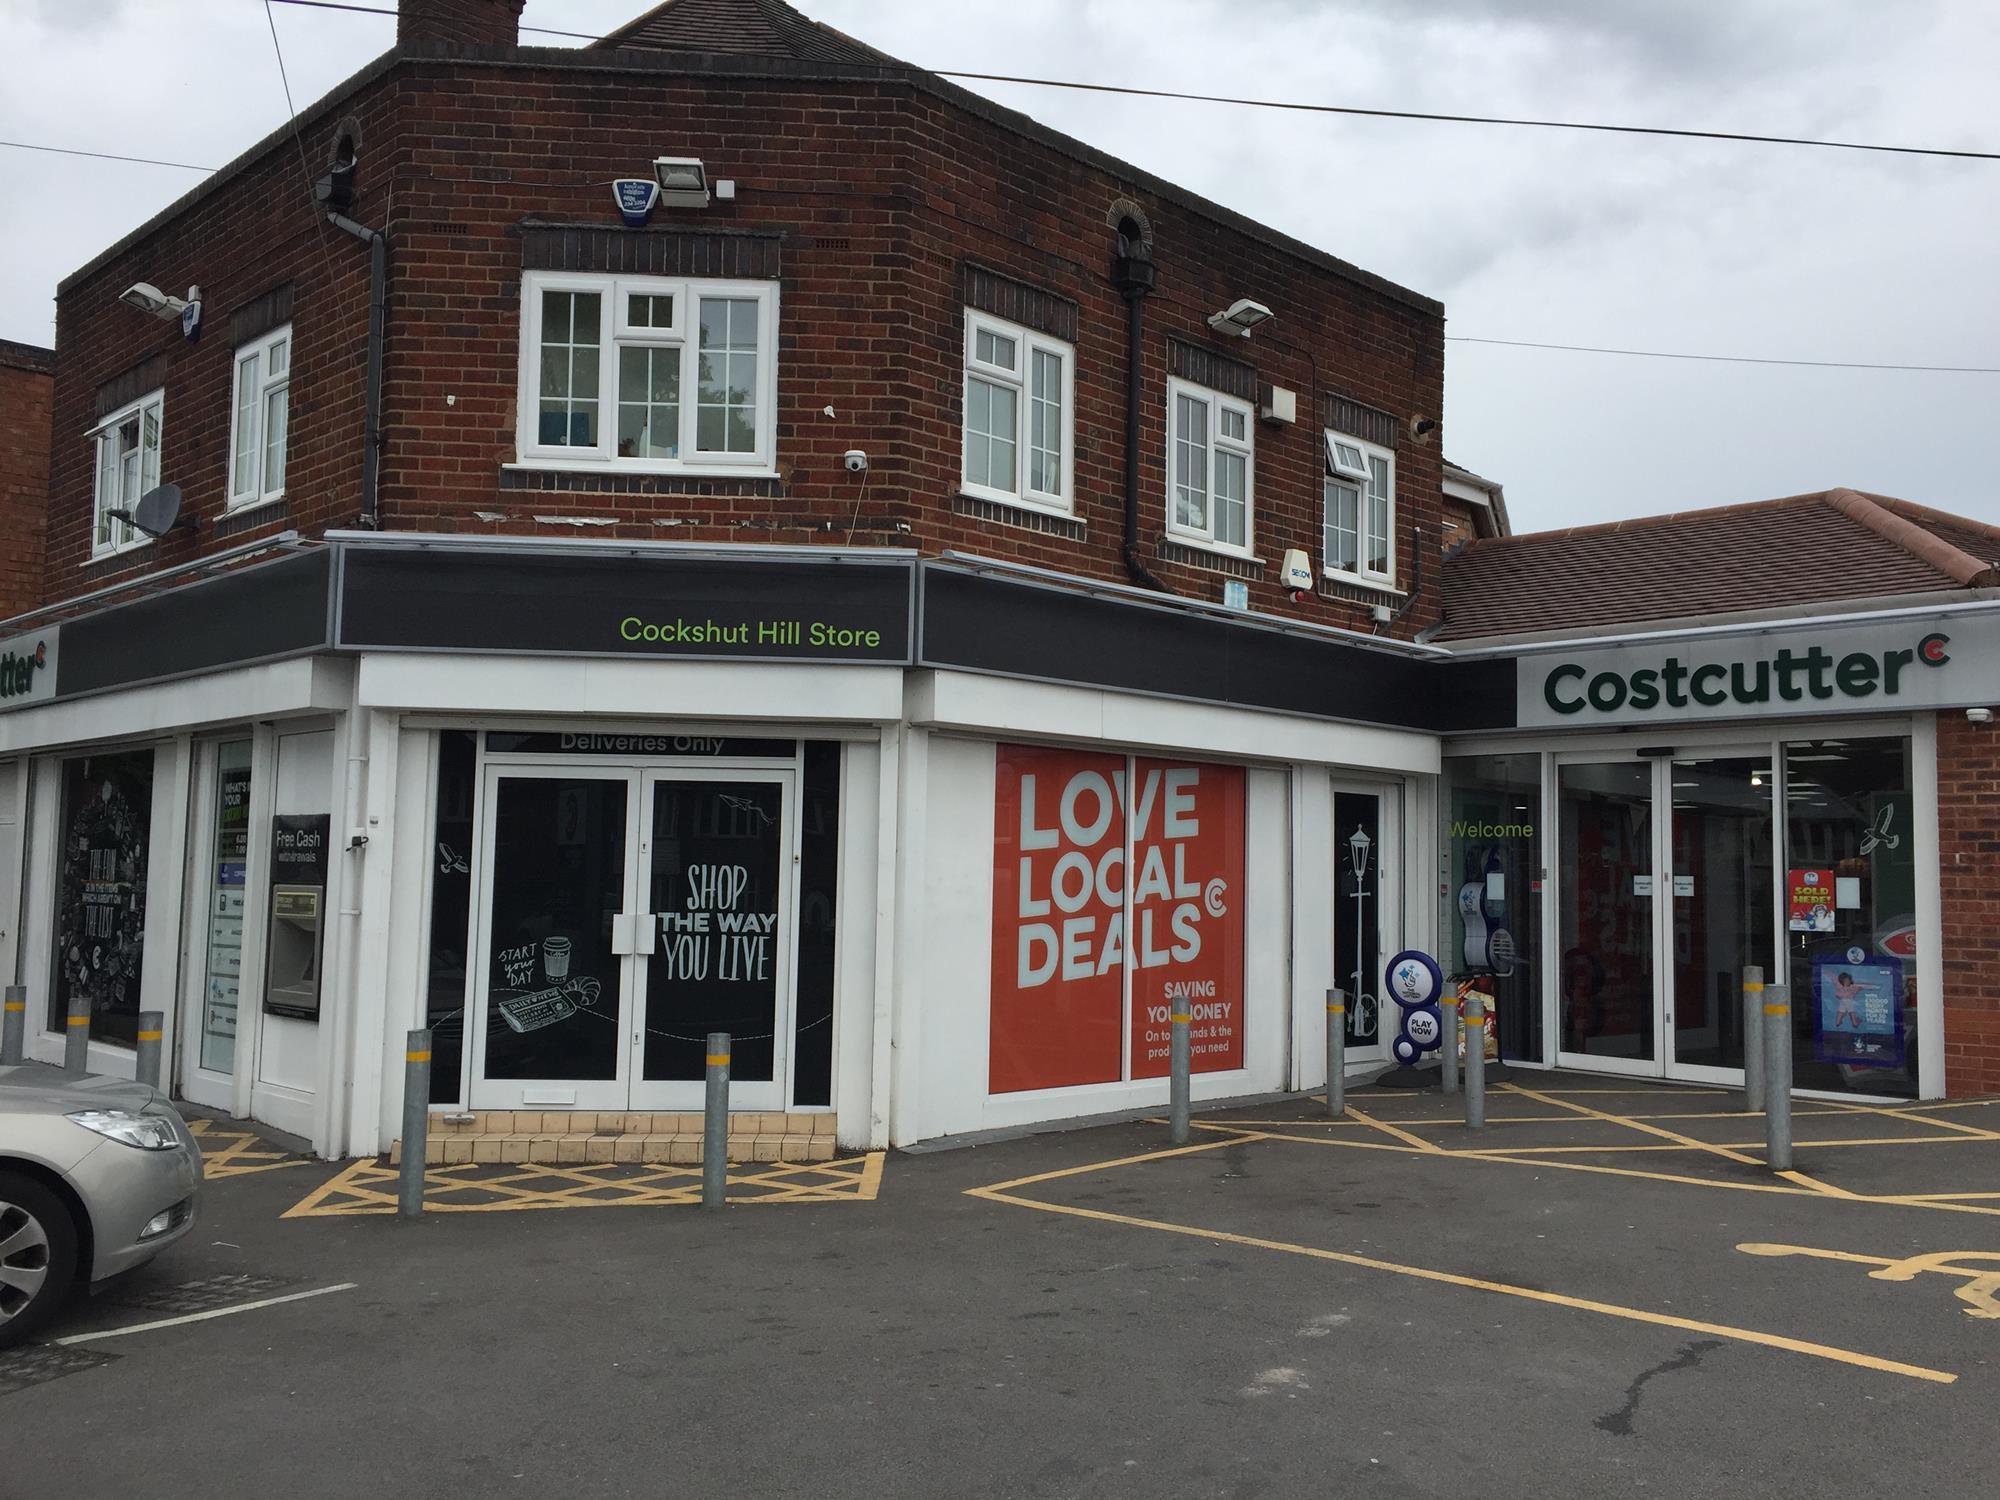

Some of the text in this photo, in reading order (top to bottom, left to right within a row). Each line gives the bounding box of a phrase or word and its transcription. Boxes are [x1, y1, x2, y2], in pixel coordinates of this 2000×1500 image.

[620, 616, 881, 648] Cockshut Hill Store
[1543, 646, 1913, 714] Costcutter
[560, 733, 725, 756] Deliveries Only
[224, 794, 241, 806] YOUR
[1020, 767, 1200, 851] LOVE
[276, 829, 320, 847] Free Cash
[1449, 819, 1534, 838] Welcome
[687, 864, 748, 910] SHOP
[1018, 843, 1201, 919] LOCAL
[1794, 886, 1829, 896] SOLD
[657, 911, 777, 934] THE WAY
[498, 942, 537, 962] START
[1017, 902, 1202, 990] DEALS
[662, 933, 771, 982] YOU LIVE
[504, 959, 535, 979] your
[510, 968, 534, 987] DAY
[1164, 979, 1216, 999] SAVING
[1147, 1005, 1171, 1024] YO
[1411, 1018, 1433, 1028] PLAY
[1145, 1025, 1232, 1042] On to nds & the
[1411, 1027, 1432, 1036] NOW
[1148, 1040, 1230, 1061] prod you need
